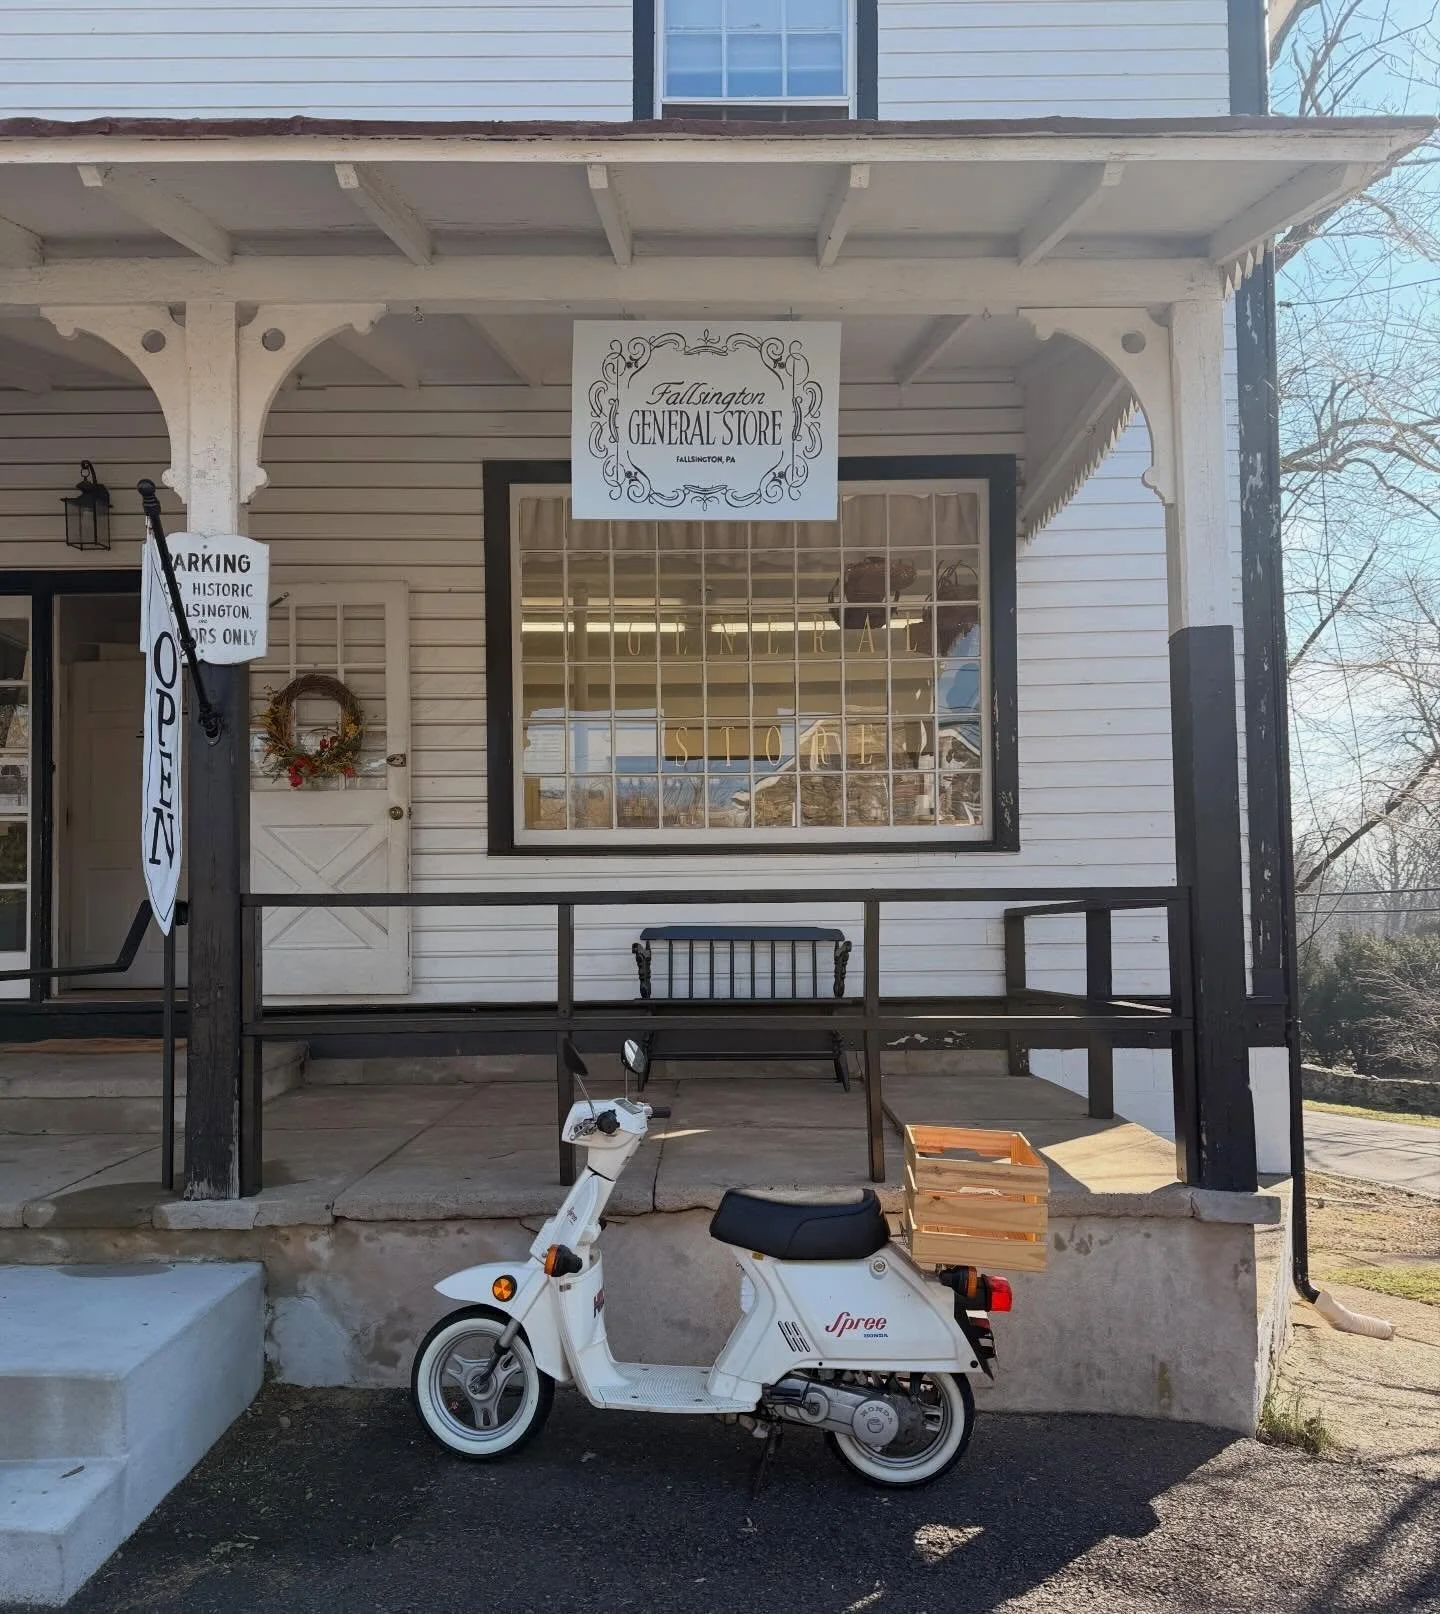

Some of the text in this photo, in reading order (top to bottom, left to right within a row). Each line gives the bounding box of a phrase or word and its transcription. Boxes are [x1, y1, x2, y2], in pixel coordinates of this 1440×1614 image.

[645, 380, 766, 414] Fallsington
[628, 410, 783, 446] GENERAL STORE
[676, 455, 736, 465] FALLSINGTON, PA
[162, 552, 251, 574] ARKING
[192, 582, 254, 598] HISTORIC
[223, 628, 258, 646] ONLY
[149, 630, 177, 869] OPEN
[675, 724, 873, 767] STORE
[825, 1311, 887, 1338] Spree
